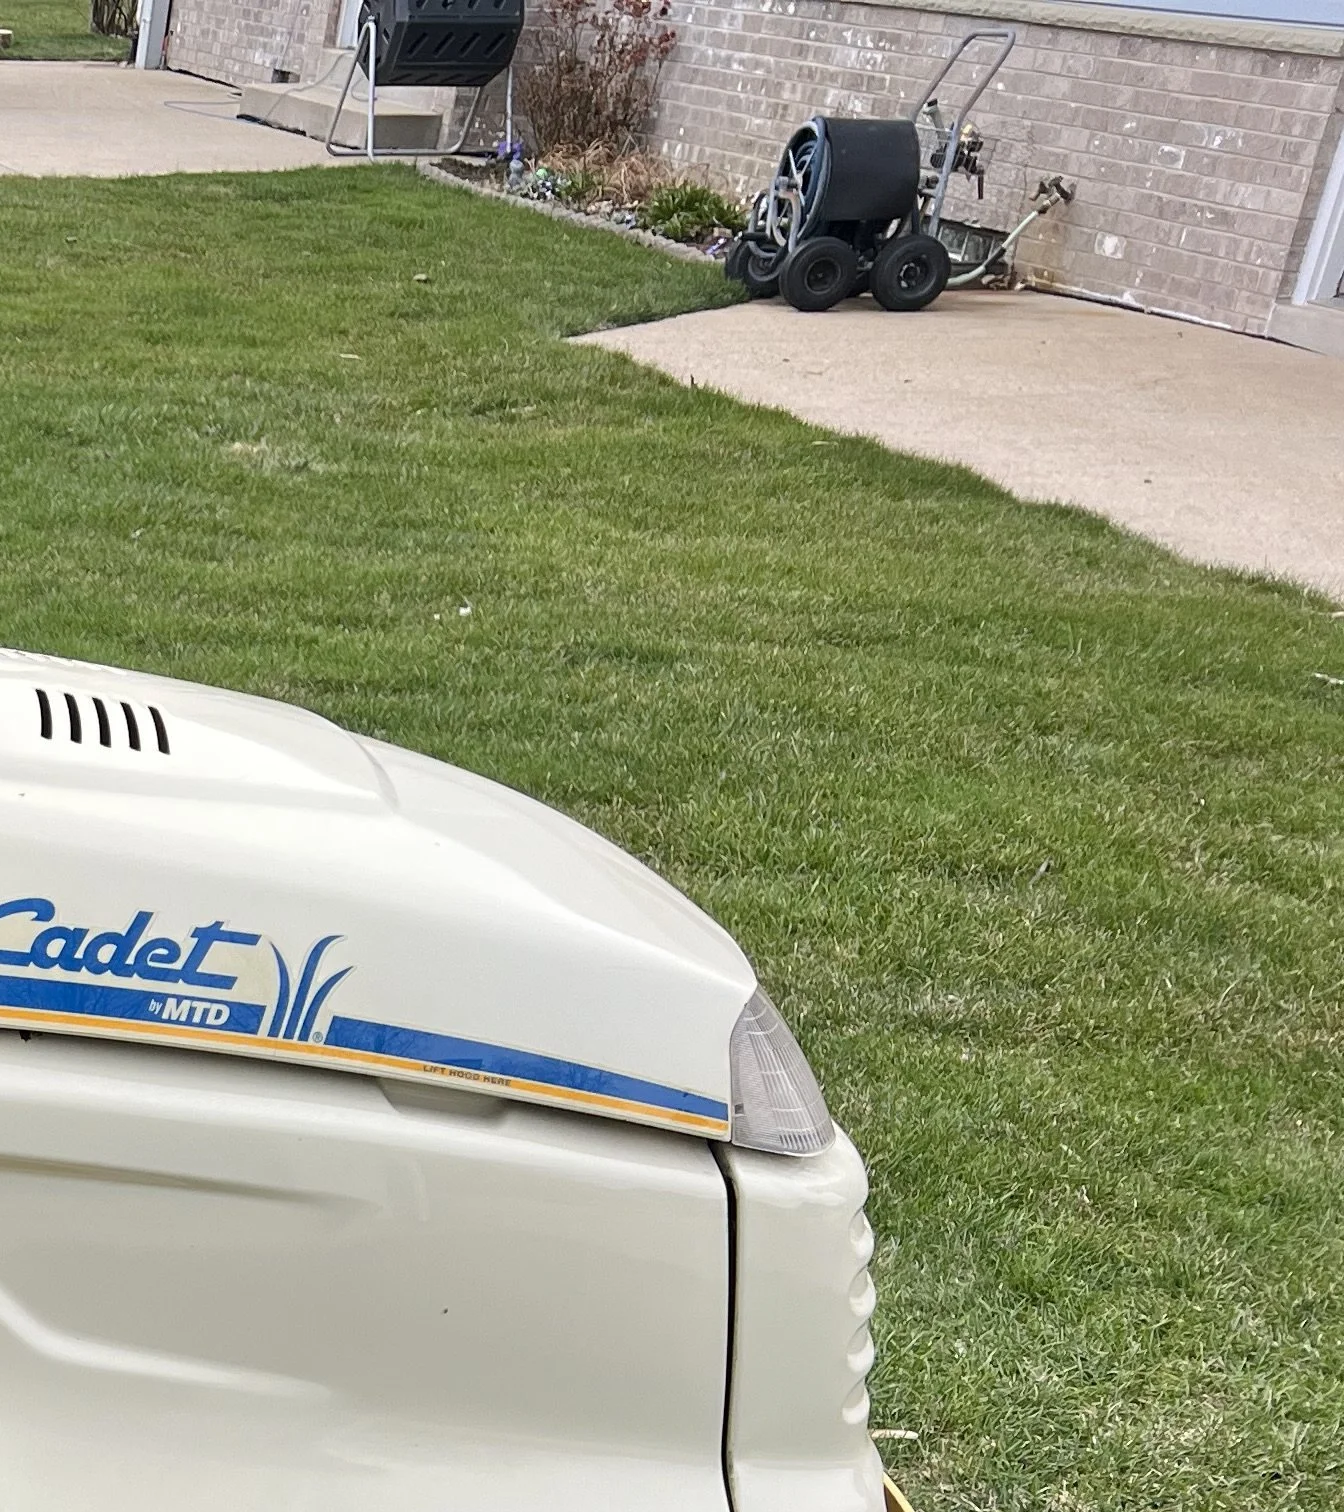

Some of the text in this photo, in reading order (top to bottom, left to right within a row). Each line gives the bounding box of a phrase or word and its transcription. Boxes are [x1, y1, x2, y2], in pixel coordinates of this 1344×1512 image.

[148, 997, 231, 1026] by MTD
[423, 1064, 447, 1076] LIFT
